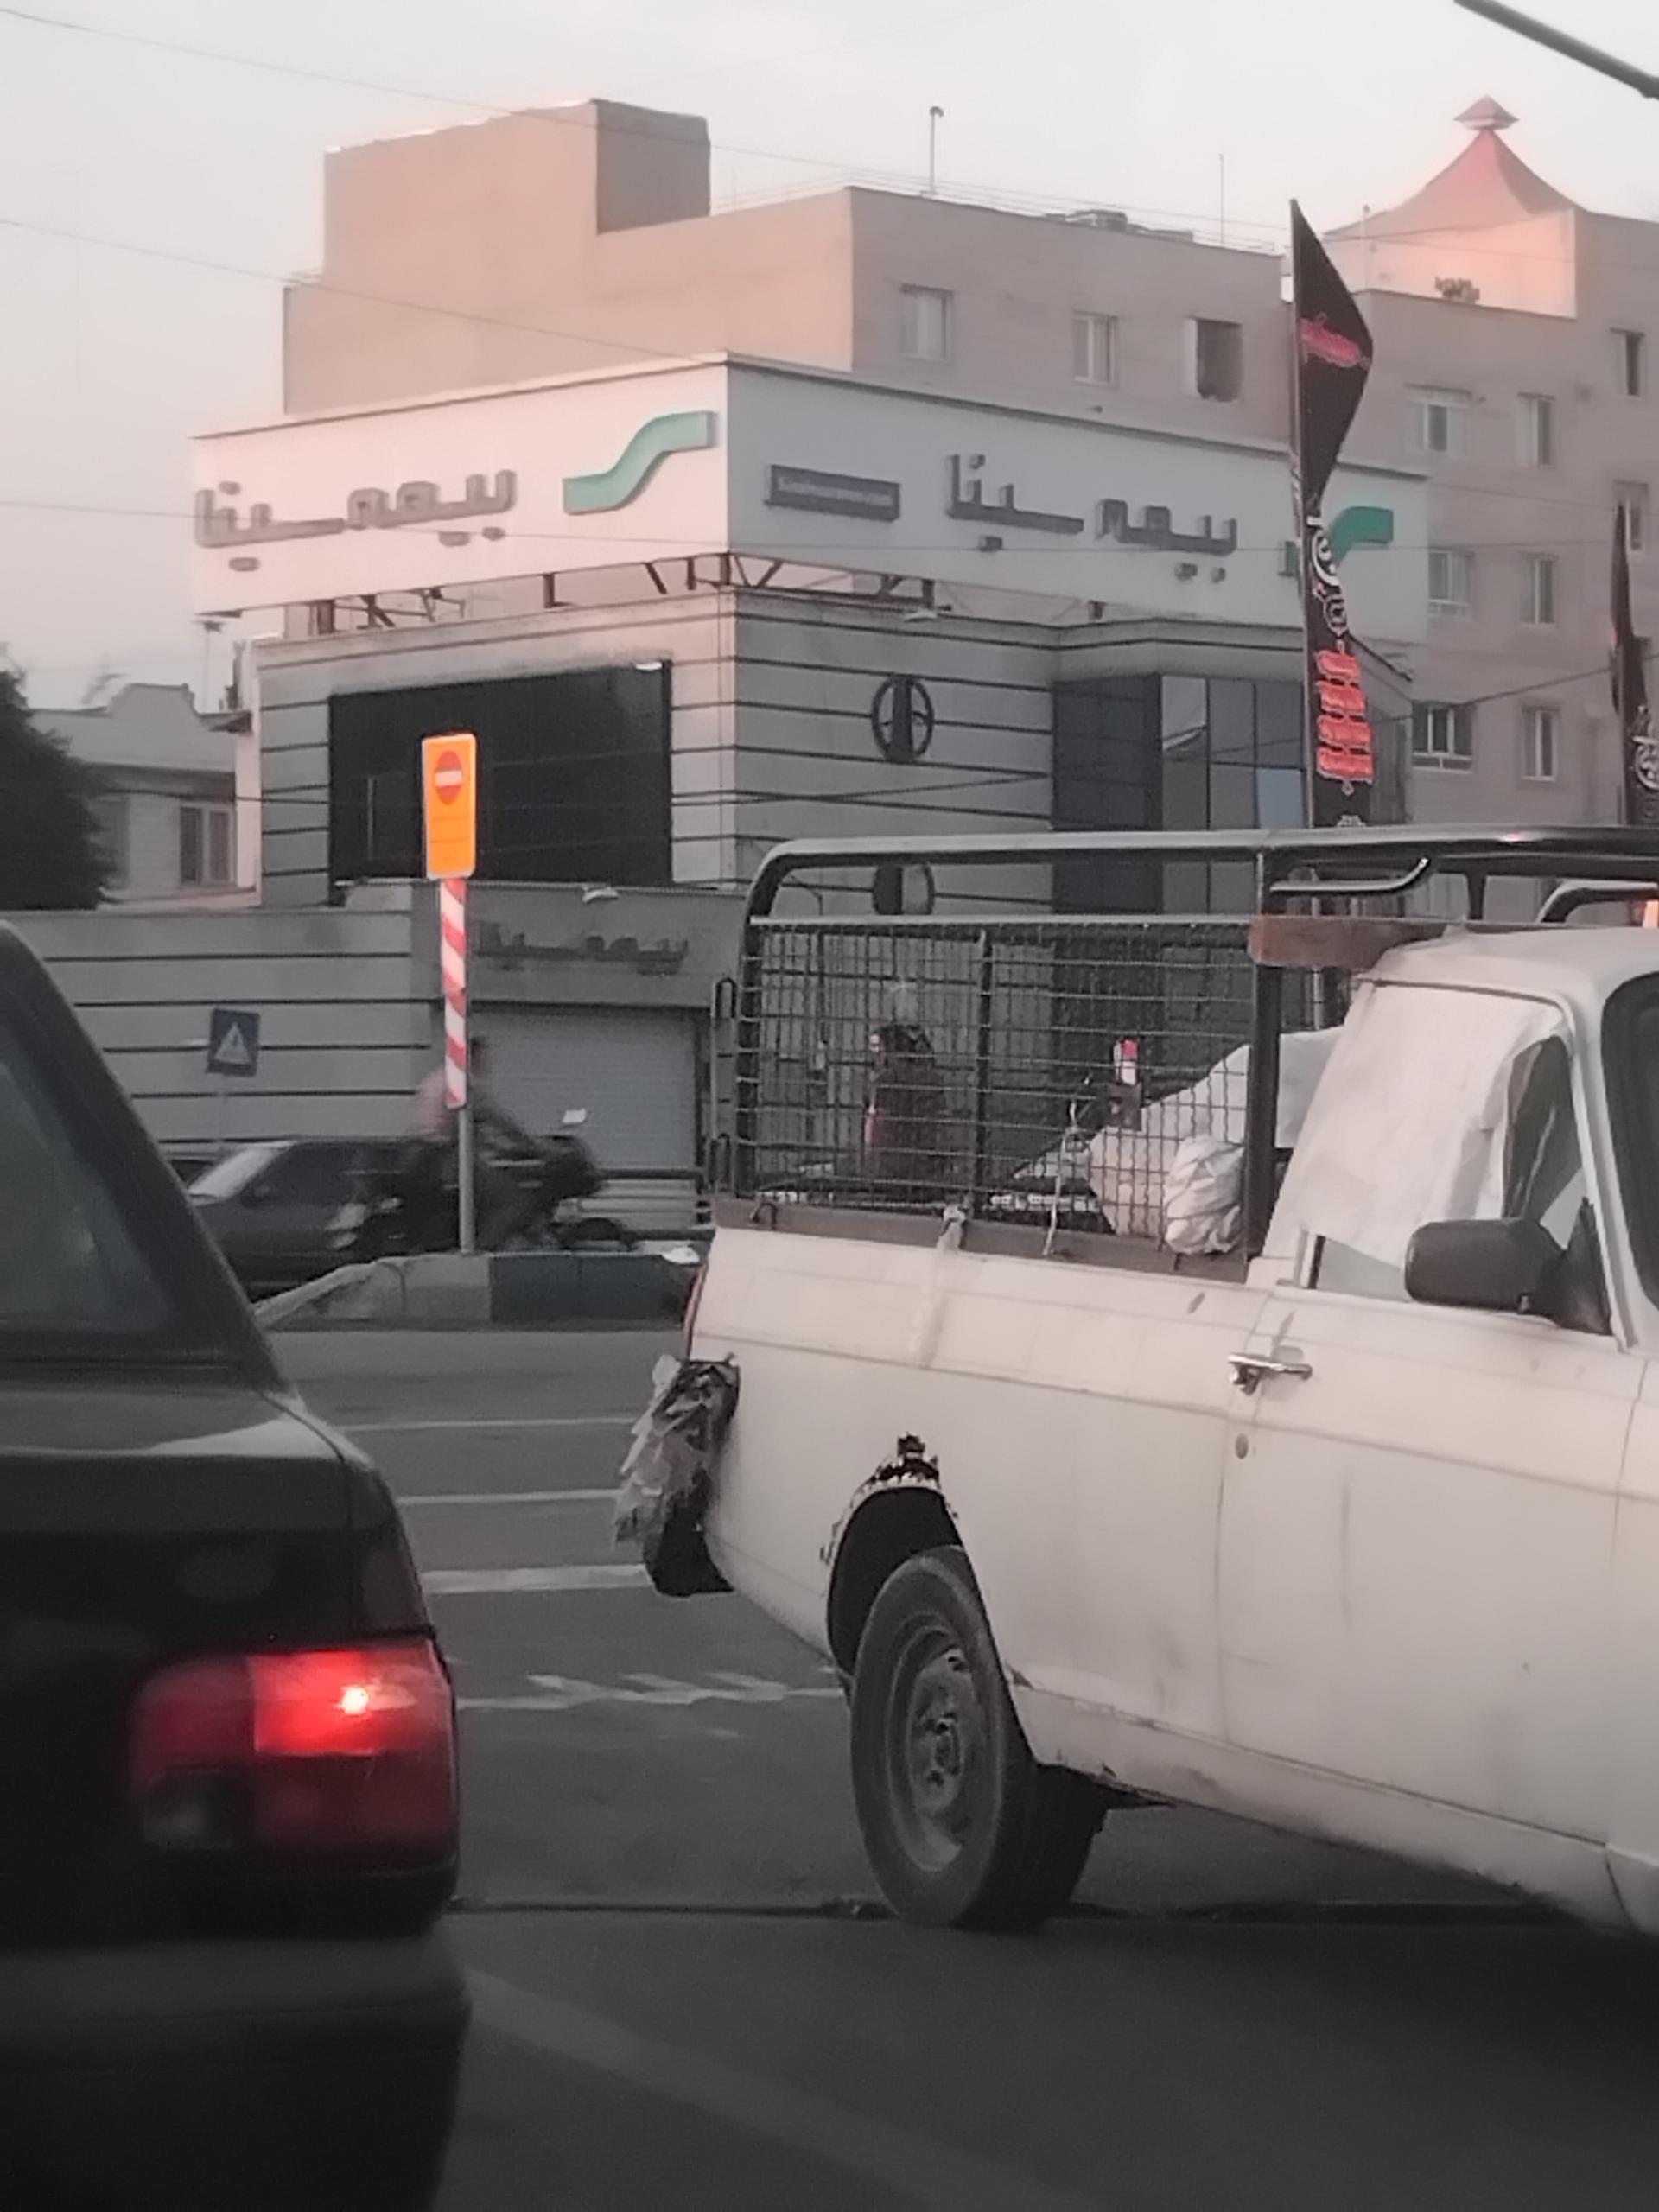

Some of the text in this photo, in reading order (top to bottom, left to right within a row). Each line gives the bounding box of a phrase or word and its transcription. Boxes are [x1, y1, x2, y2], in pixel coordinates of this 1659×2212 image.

[194, 467, 517, 572] بیمه سینا
[946, 454, 1084, 553] سینا
[1096, 498, 1237, 583] بیمه
